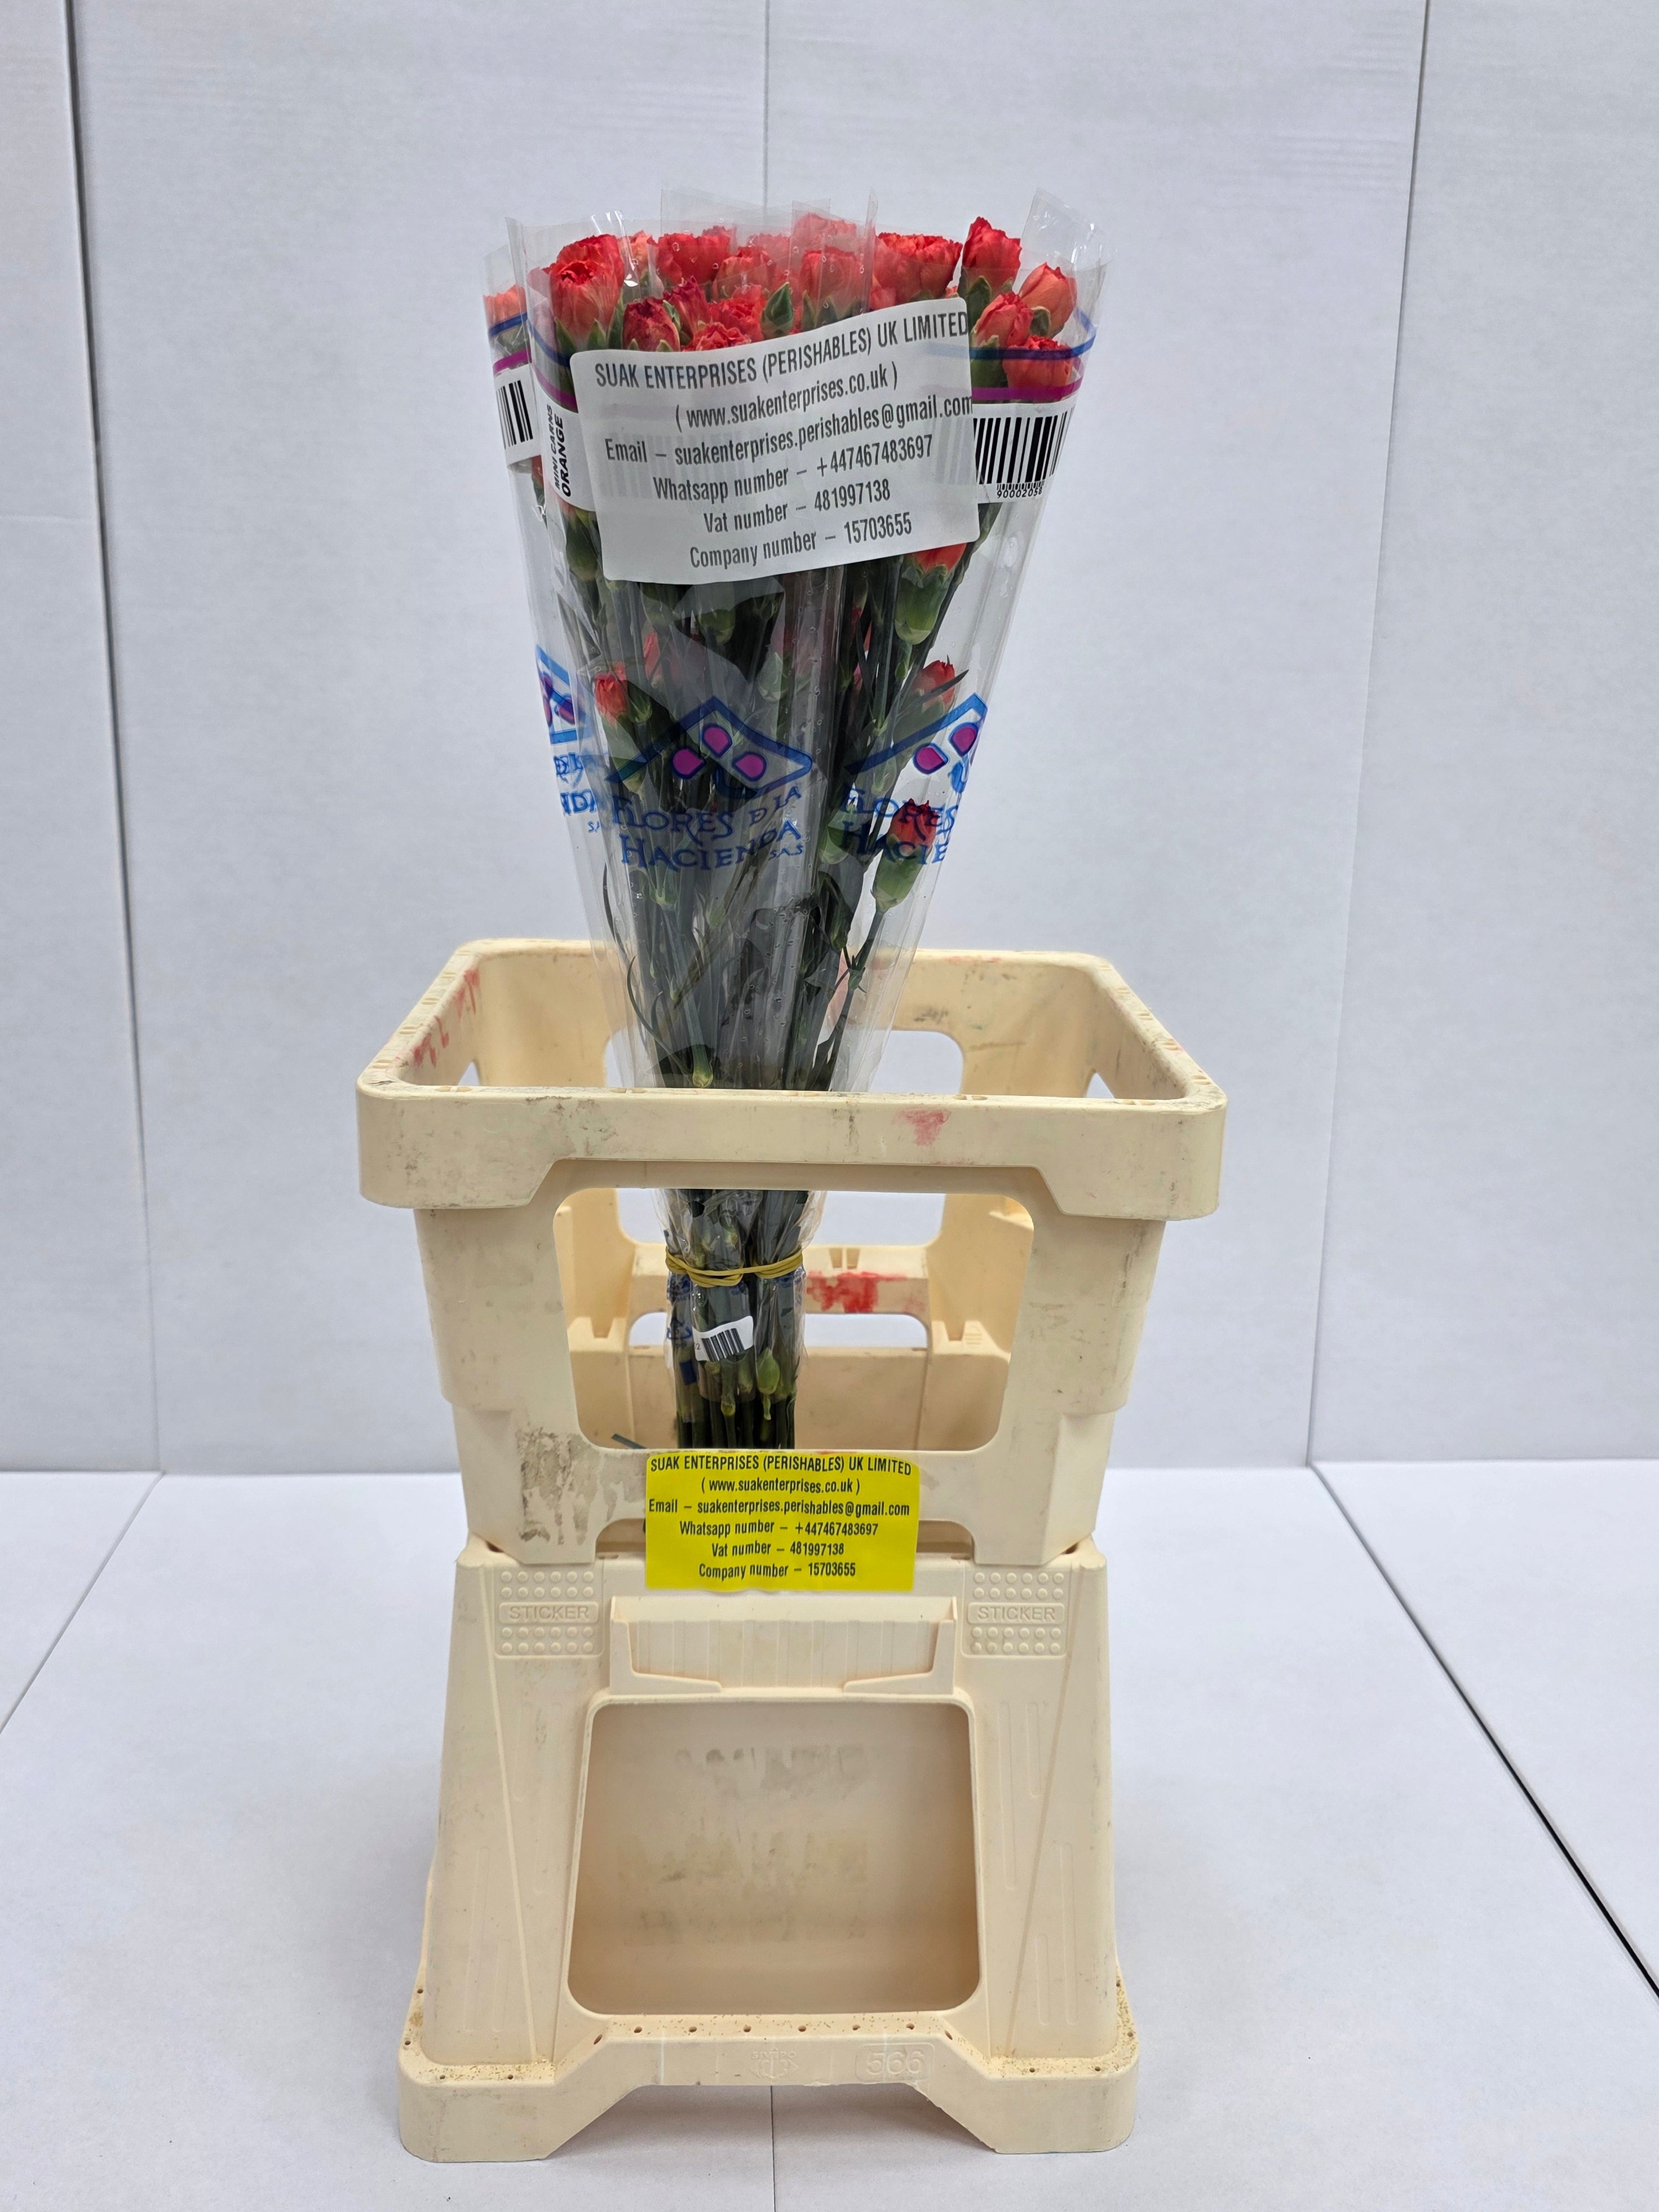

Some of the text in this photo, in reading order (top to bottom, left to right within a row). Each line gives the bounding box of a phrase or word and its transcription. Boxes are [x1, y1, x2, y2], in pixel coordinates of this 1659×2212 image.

[594, 311, 968, 389] SUAK ENTERPRISES (PERISHABLES) UK LIMITED
[686, 364, 888, 428] www.suakenterprises.co.uk
[547, 404, 557, 455] CARNS
[605, 438, 648, 463] Email
[675, 394, 973, 465] suakenterprises.perishables@gmail.com
[554, 414, 571, 497] ORANGE
[653, 477, 729, 504] Whatsapp
[734, 467, 789, 497] number
[816, 434, 933, 477] +447467483697
[703, 513, 729, 533] Vat
[734, 503, 788, 531] number
[814, 478, 890, 512] 481997138
[690, 545, 758, 570] Company
[763, 530, 816, 560] number
[844, 512, 912, 544] 15703655
[612, 795, 734, 846] FLORES
[619, 819, 801, 873] HACIENDA
[650, 1455, 911, 1476] SUAK ENTERPRISES (PERISHABLES) UK LIMITED
[709, 1477, 853, 1494] www.suakenterprises.co.uk
[649, 1498, 678, 1512] Email
[697, 1499, 910, 1518] suakenterprises.perishables@gmail.com
[680, 1520, 731, 1538] Whatsapp
[734, 1519, 774, 1535] number
[795, 1521, 879, 1536] +447467483697
[698, 1563, 747, 1582] Company
[749, 1563, 789, 1578] number
[808, 1562, 856, 1577] 15703655
[711, 1542, 728, 1557] Vat
[732, 1540, 771, 1556] number
[790, 1541, 844, 1556] 481997138
[509, 1605, 589, 1620] STICKER
[978, 1606, 1056, 1621] STICKER
[865, 2051, 925, 2075] 566
